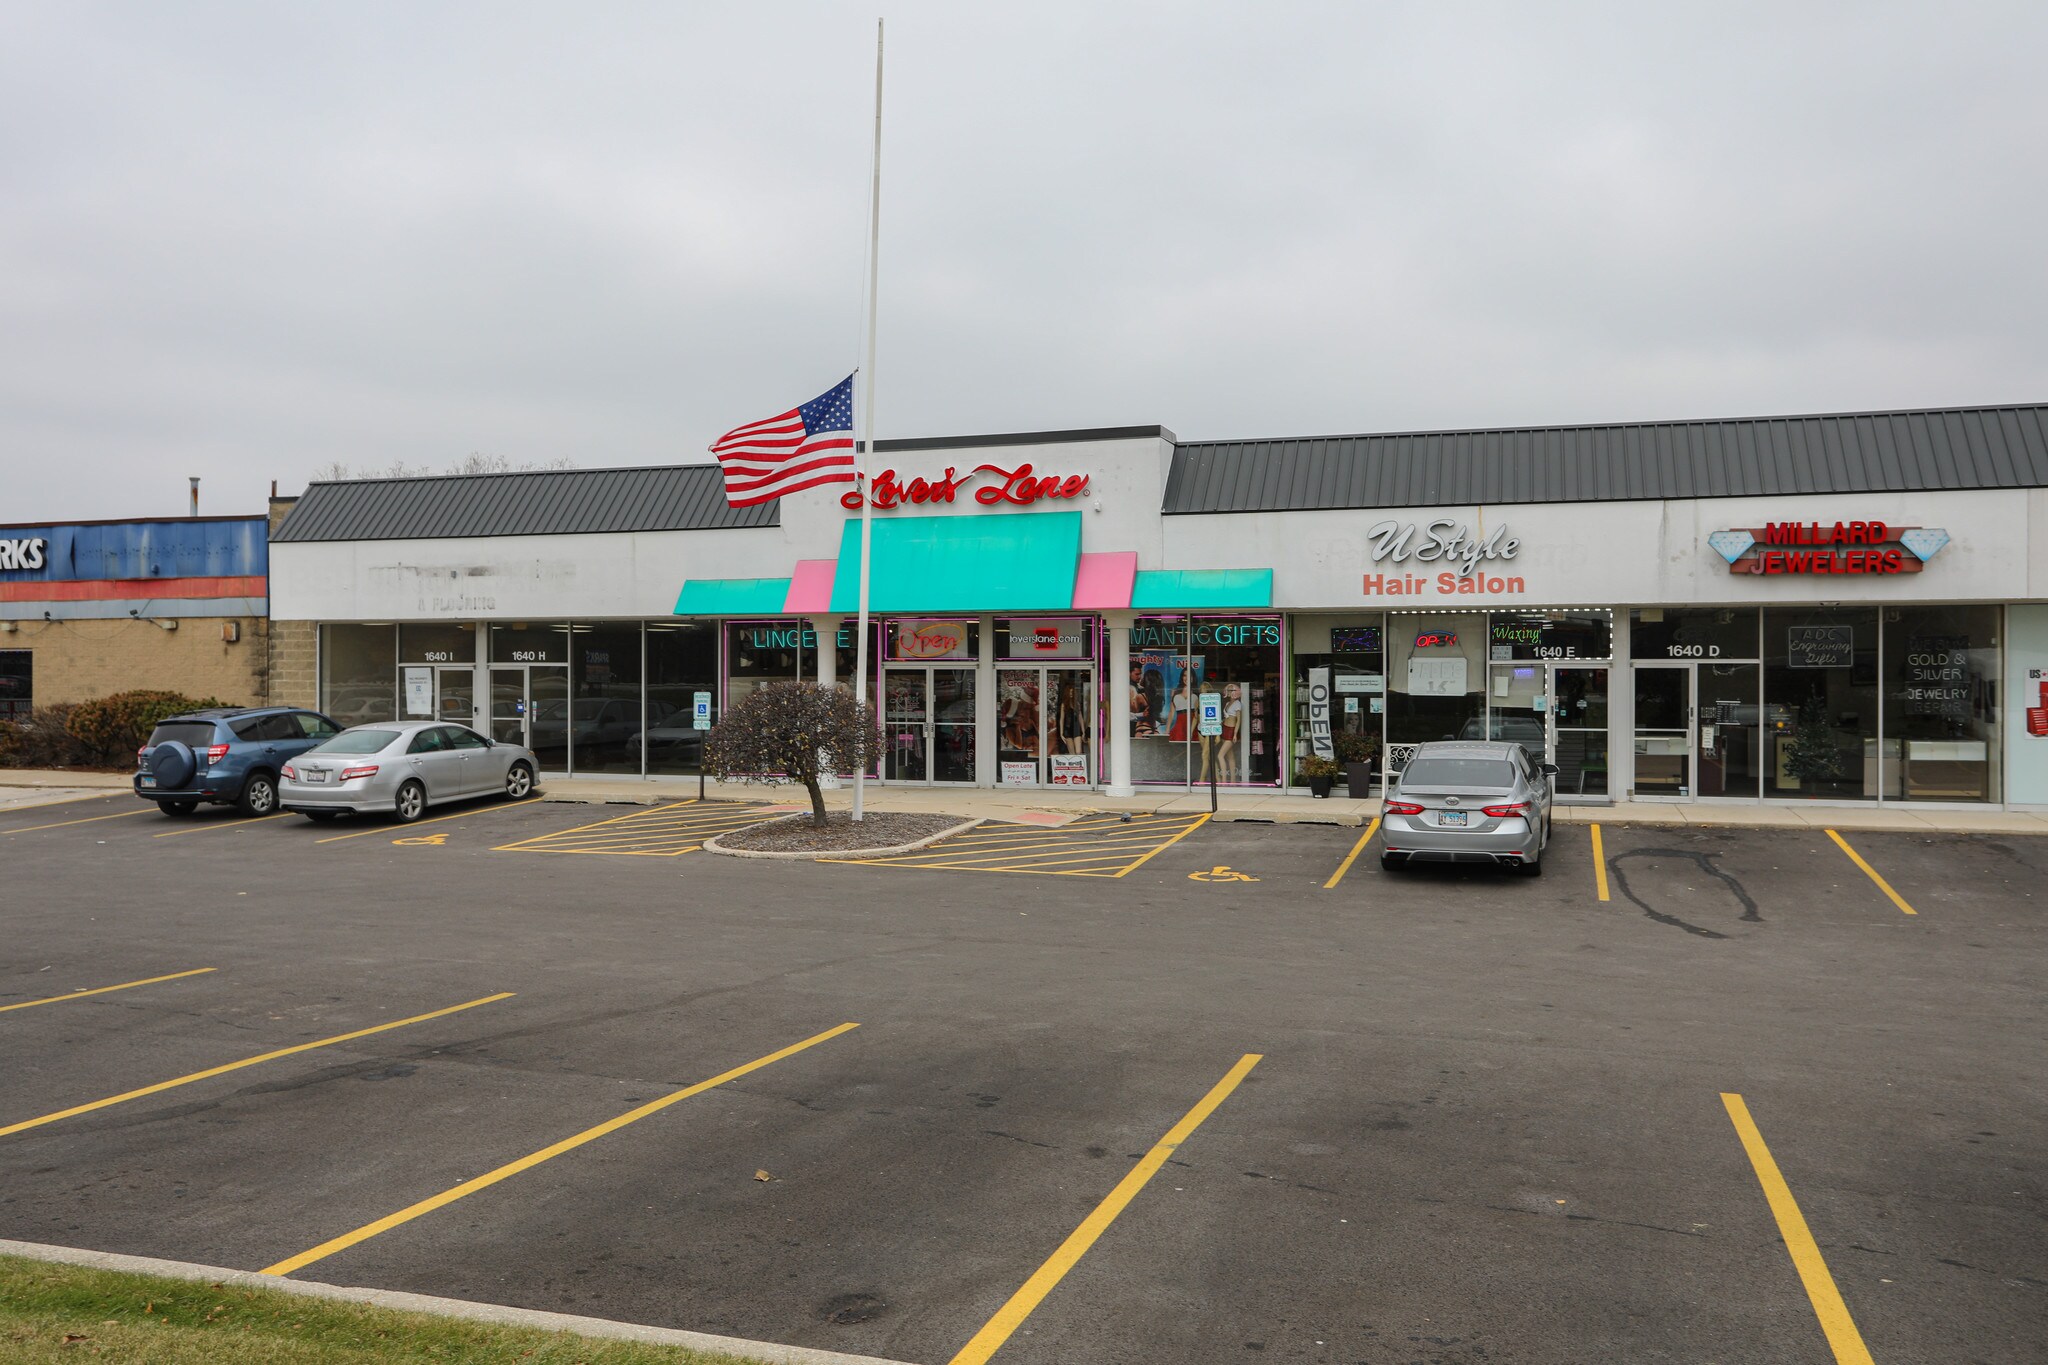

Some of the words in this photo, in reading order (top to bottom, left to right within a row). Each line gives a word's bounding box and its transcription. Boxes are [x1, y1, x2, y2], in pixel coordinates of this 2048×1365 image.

[971, 463, 1090, 506] Lane
[1766, 521, 1888, 545] MILLARD
[0, 537, 45, 570] RKS
[1750, 550, 1904, 575] JEWELERS
[1363, 573, 1428, 596] Hair
[1437, 572, 1525, 595] Salon
[754, 630, 850, 649] LINGEE
[900, 627, 957, 652] Open
[1009, 634, 1080, 643] loverslane.com
[1103, 625, 1212, 646] MANTIC
[1214, 625, 1280, 645] GIFTS
[1416, 635, 1457, 647] OPEN
[1493, 627, 1540, 644] Waxing
[1533, 647, 1563, 657] 1640
[1566, 647, 1575, 657] E
[1667, 645, 1703, 657] 1640
[1709, 645, 1720, 657] D
[1790, 640, 1852, 653] Engraving
[425, 651, 447, 661] 1640
[449, 651, 453, 661] I
[512, 651, 535, 661] 1640
[538, 651, 546, 661] H
[1804, 652, 1837, 665] Gifts
[1907, 653, 1949, 666] GOLD
[1953, 653, 1966, 665] &
[1176, 659, 1200, 670] Nie
[1913, 668, 1962, 681] SILVER
[2029, 669, 2041, 679] US
[1907, 689, 1968, 700] JEWELRY
